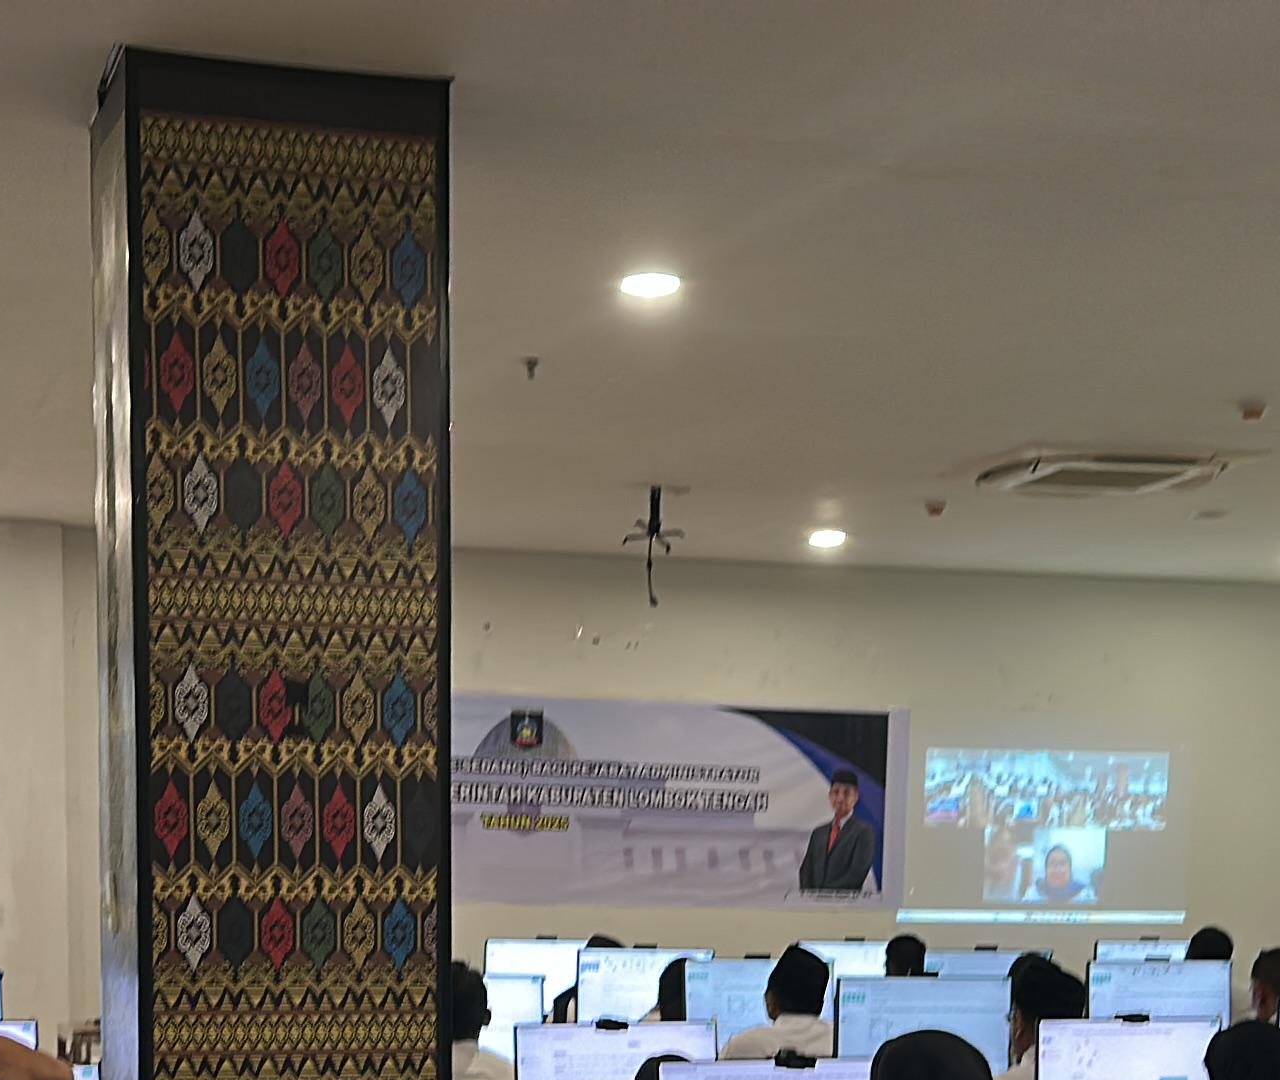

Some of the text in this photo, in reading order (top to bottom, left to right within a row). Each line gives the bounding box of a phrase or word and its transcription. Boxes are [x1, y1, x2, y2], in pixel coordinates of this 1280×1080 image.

[526, 784, 625, 808] KABUPATEN
[628, 787, 703, 810] LOMBOK
[480, 812, 532, 830] TAHUN
